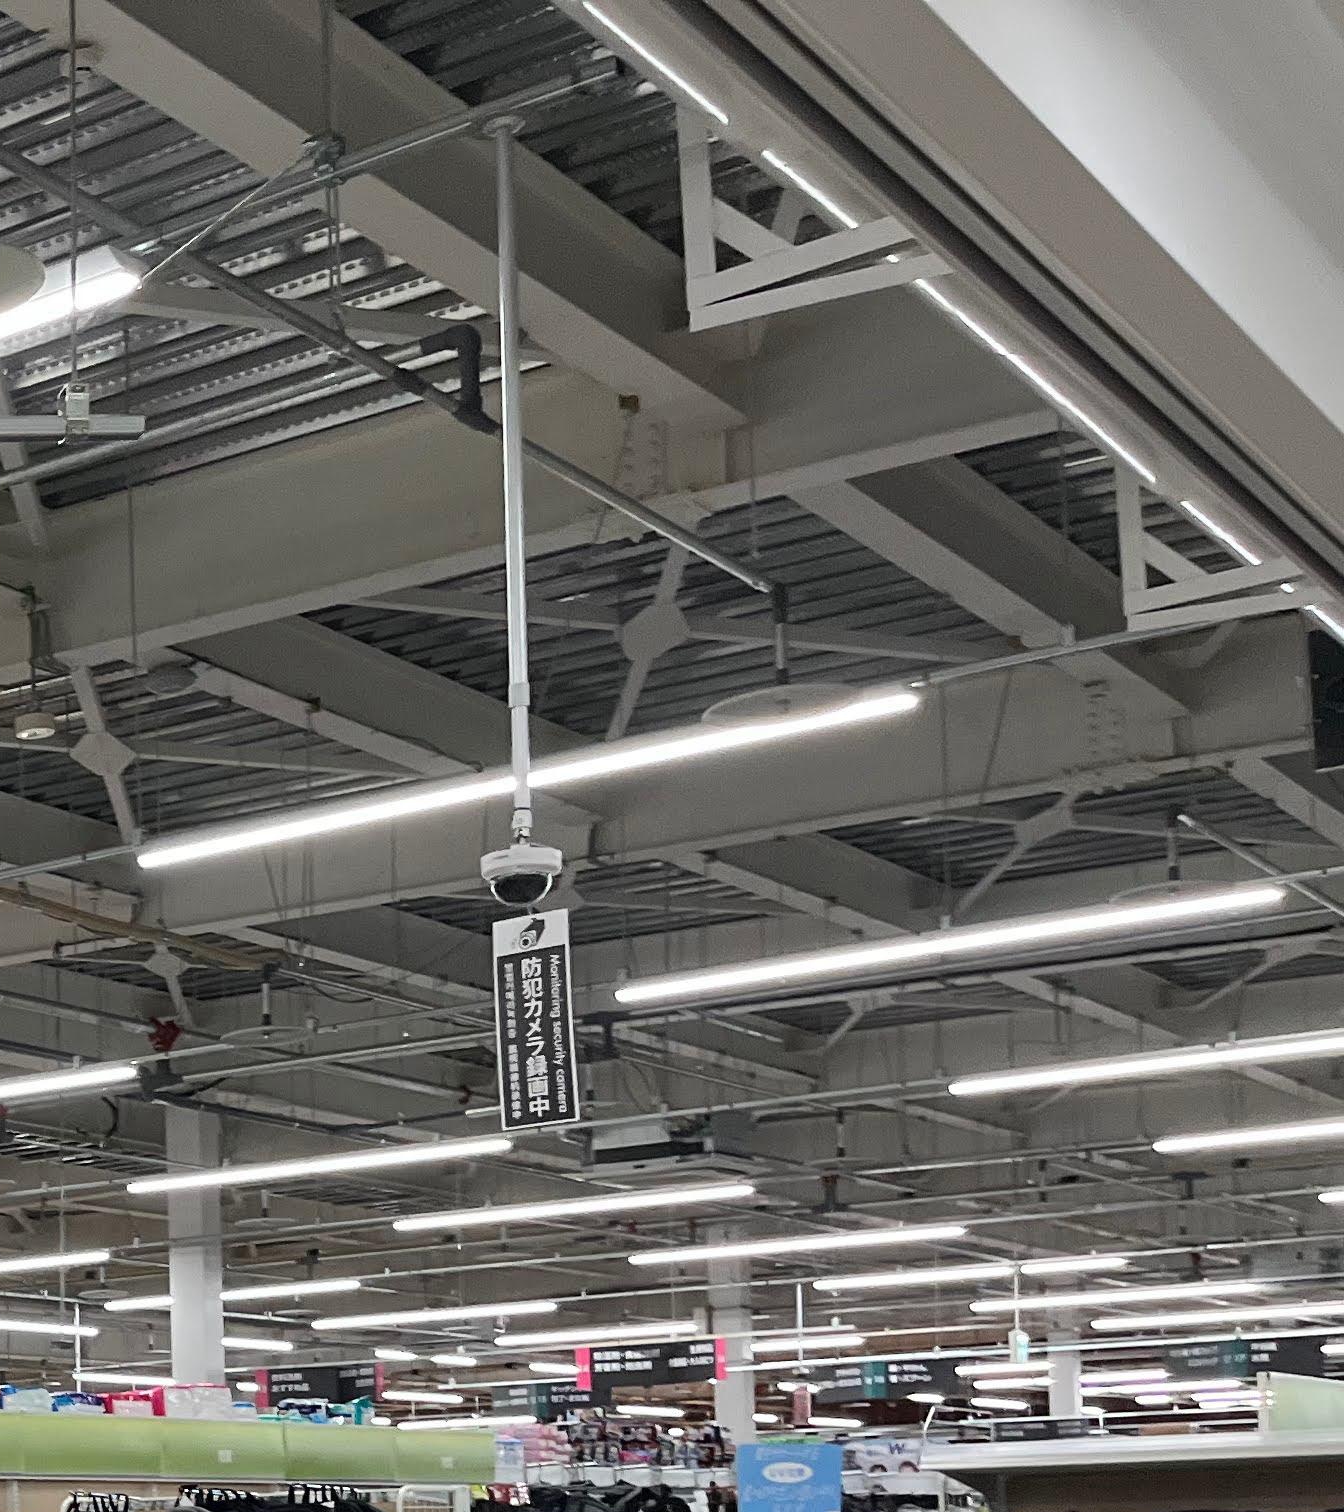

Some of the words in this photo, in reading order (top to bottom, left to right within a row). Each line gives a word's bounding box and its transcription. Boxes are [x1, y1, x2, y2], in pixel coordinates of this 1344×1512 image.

[520, 956, 551, 1118] 防犯カメラ録画中
